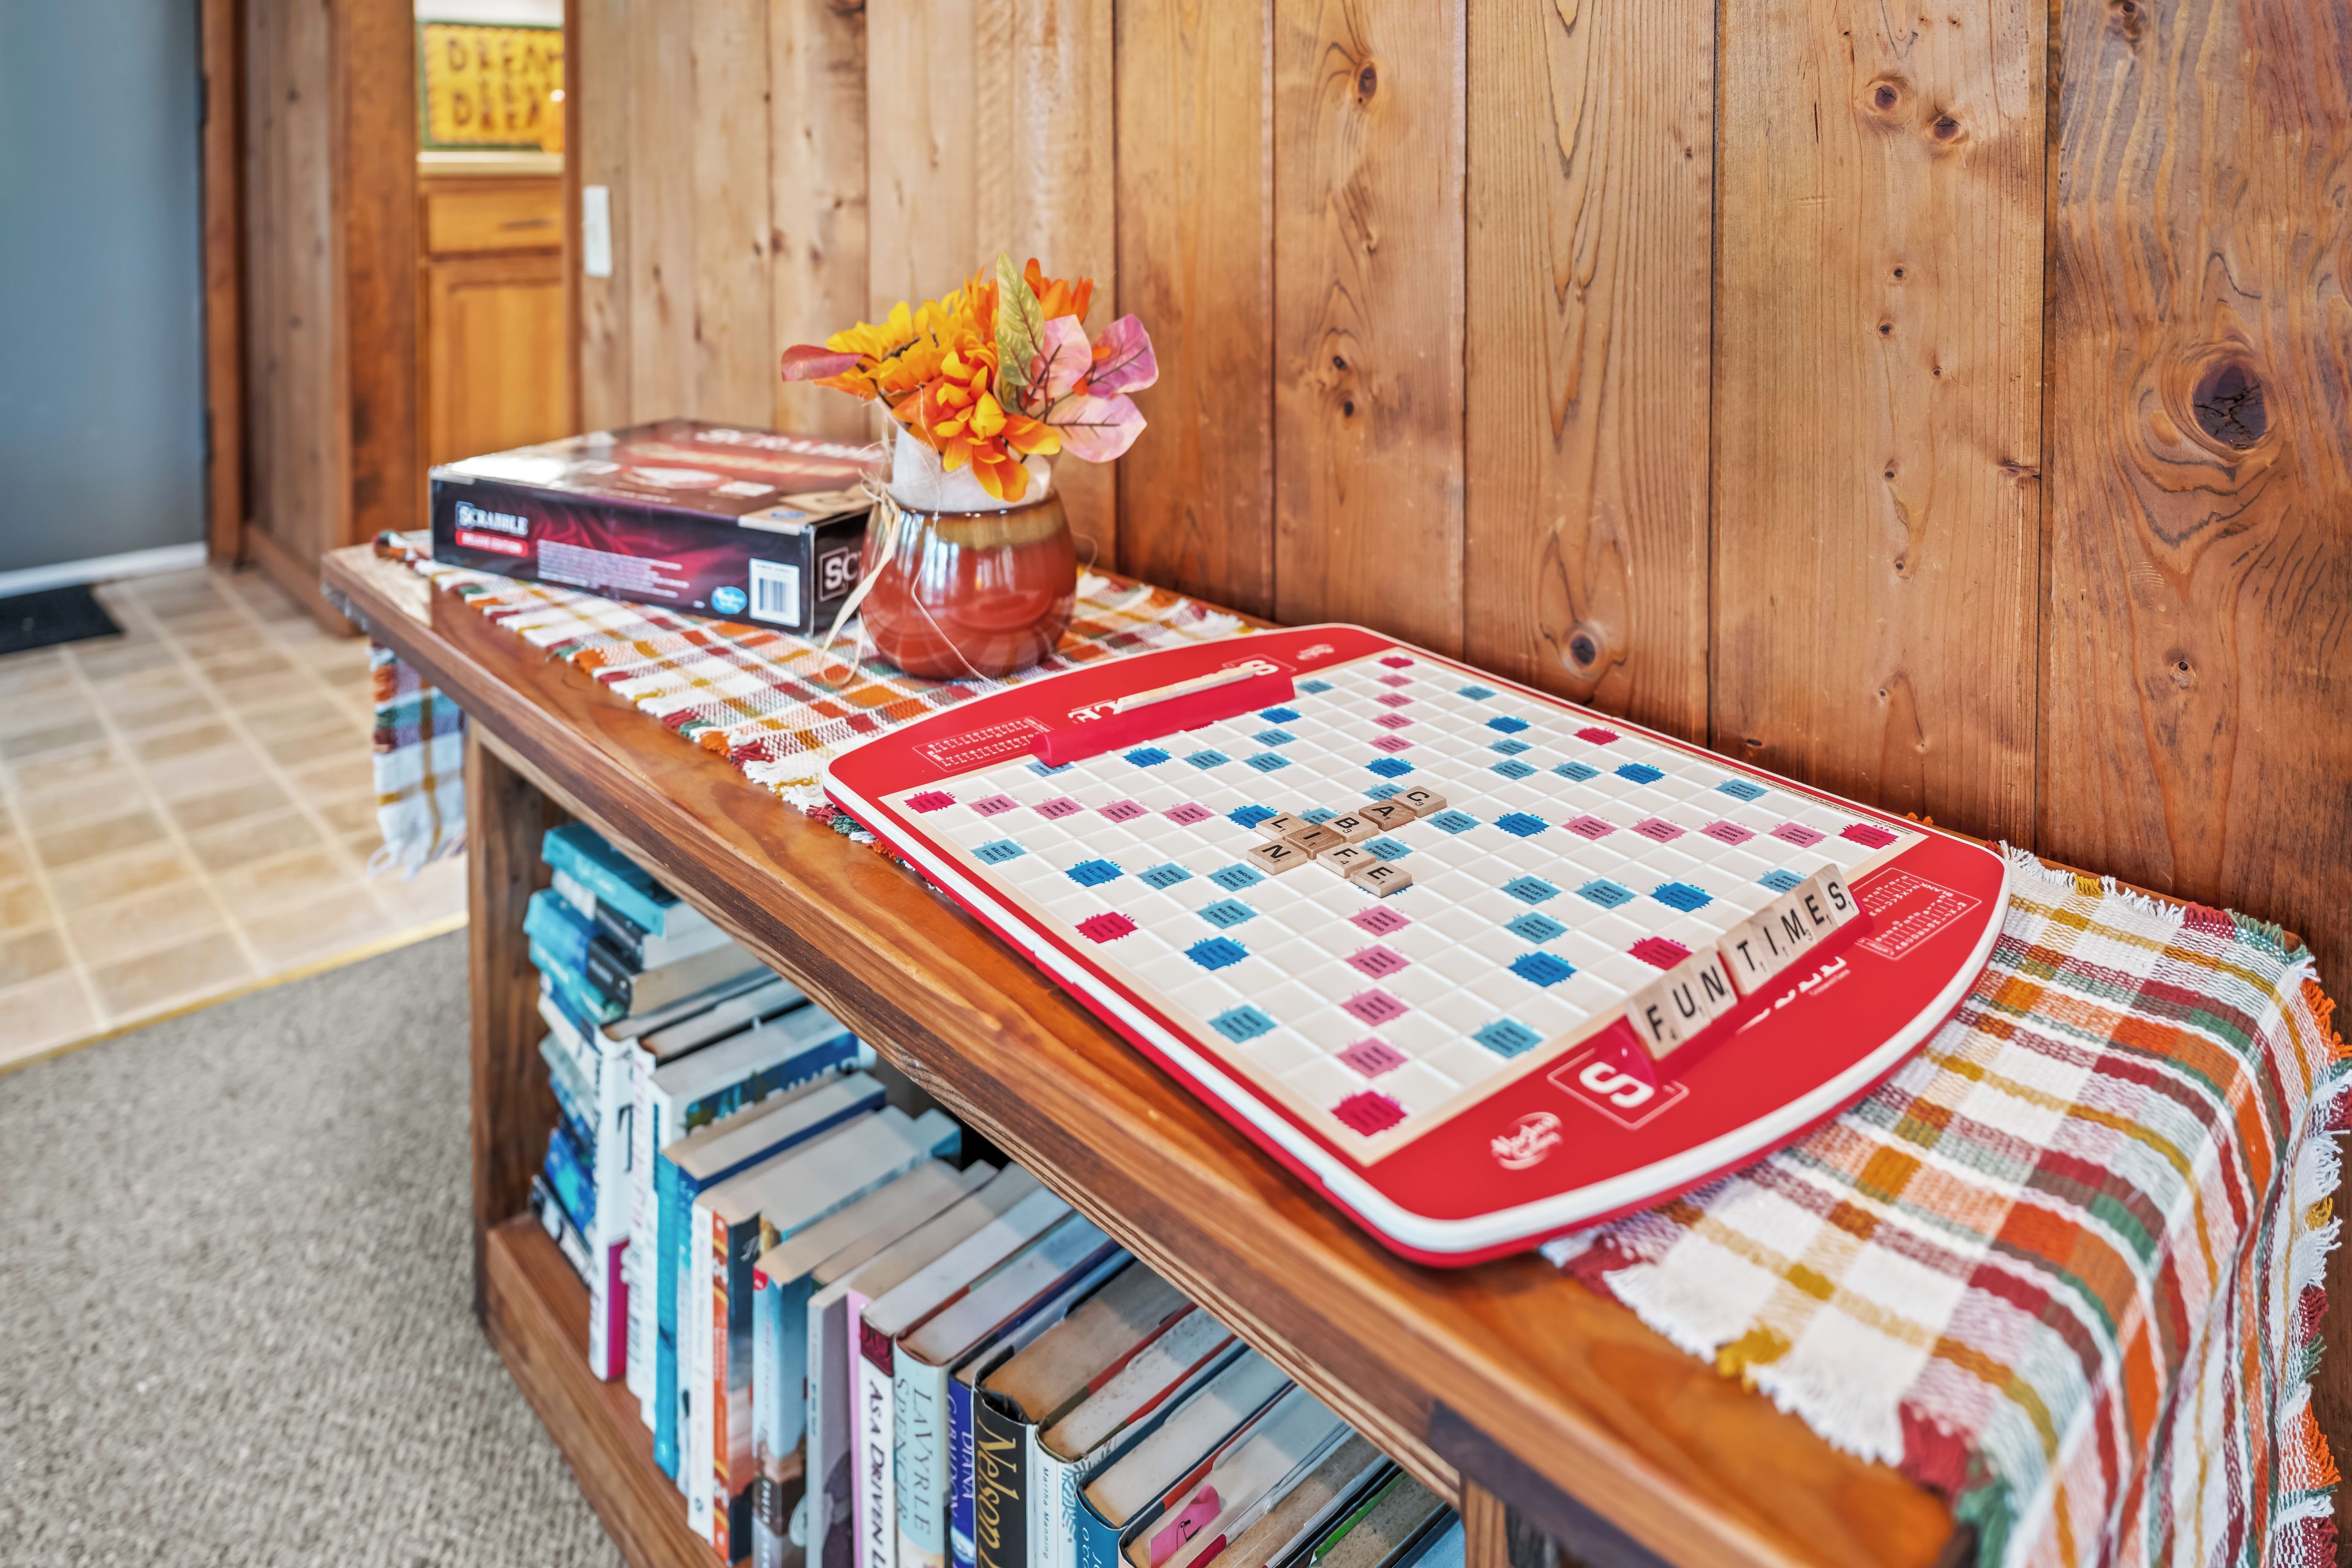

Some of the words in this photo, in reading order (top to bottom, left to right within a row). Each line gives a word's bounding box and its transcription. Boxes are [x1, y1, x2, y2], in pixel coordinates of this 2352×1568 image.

[978, 803, 995, 813] DOUBLE
[995, 799, 1009, 807] SCORE
[1058, 801, 1074, 810] SCORE
[1042, 806, 1059, 816] DOUBLE
[1106, 809, 1125, 819] DOUBLE
[1123, 805, 1139, 813] SCORE
[1188, 807, 1205, 816] SCORE
[1171, 812, 1190, 822] DOUBLE
[1244, 812, 1263, 821] ETTER
[1303, 817, 1322, 826] OUBLE
[1450, 815, 1469, 824] SCORE
[1436, 820, 1458, 830] DOUBLE
[1442, 817, 1464, 827] LETTER
[1586, 820, 1607, 829] SCORE
[1572, 825, 1596, 835] DOUBLE
[1581, 823, 1600, 832] WORD
[1641, 827, 1665, 838] DOUBLE
[1649, 826, 1670, 834] WORD
[1654, 823, 1676, 832] SCORE
[1723, 826, 1746, 835] SCORE
[1791, 828, 1814, 837] SCORE
[1709, 830, 1736, 841] DOUBLE
[1779, 833, 1806, 843] DOUBLE
[1787, 831, 1808, 840] WORD
[1000, 845, 1016, 854] SCORE
[1374, 845, 1395, 856] LETTER
[1381, 842, 1401, 852] SCORE
[981, 850, 999, 861] DOUBLE
[990, 847, 1008, 858] LETTER
[1366, 847, 1389, 859] DOUBLE
[1085, 868, 1104, 880] LETTER
[1095, 865, 1112, 876] SCORE
[1166, 869, 1183, 879] SCORE
[1235, 869, 1254, 880] SCORE
[1077, 872, 1095, 882] TRIPLE
[1147, 874, 1168, 886] DOUBLE
[1156, 871, 1176, 883] LETTER
[1218, 875, 1240, 886] DOUBLE
[1226, 872, 1247, 883] LETTER
[1773, 877, 1796, 887] ETTER
[1781, 875, 1800, 883] CORE
[1518, 884, 1543, 896] LETTER
[1527, 882, 1550, 893] SCORE
[1767, 880, 1790, 891] OUBLE
[1512, 888, 1537, 900] DOUBLE
[1593, 888, 1619, 900] LETTER
[1601, 886, 1624, 896] SCORE
[1586, 891, 1612, 903] DOUBLE
[1216, 907, 1238, 920] LETTER
[1226, 905, 1246, 916] SCORE
[1207, 910, 1230, 924] DOUBLE
[1371, 916, 1390, 926] WORD
[1376, 911, 1398, 922] SCORE
[1360, 918, 1385, 931] DOUBLE
[1523, 921, 1549, 935] LETTER
[1532, 919, 1556, 931] SCORE
[1515, 925, 1542, 938] DOUBLE
[1646, 965, 1725, 1041] FUN
[1736, 881, 1847, 971] TIMES
[977, 1415, 1020, 1549] Nelson
[870, 1442, 884, 1545] DRIVEN
